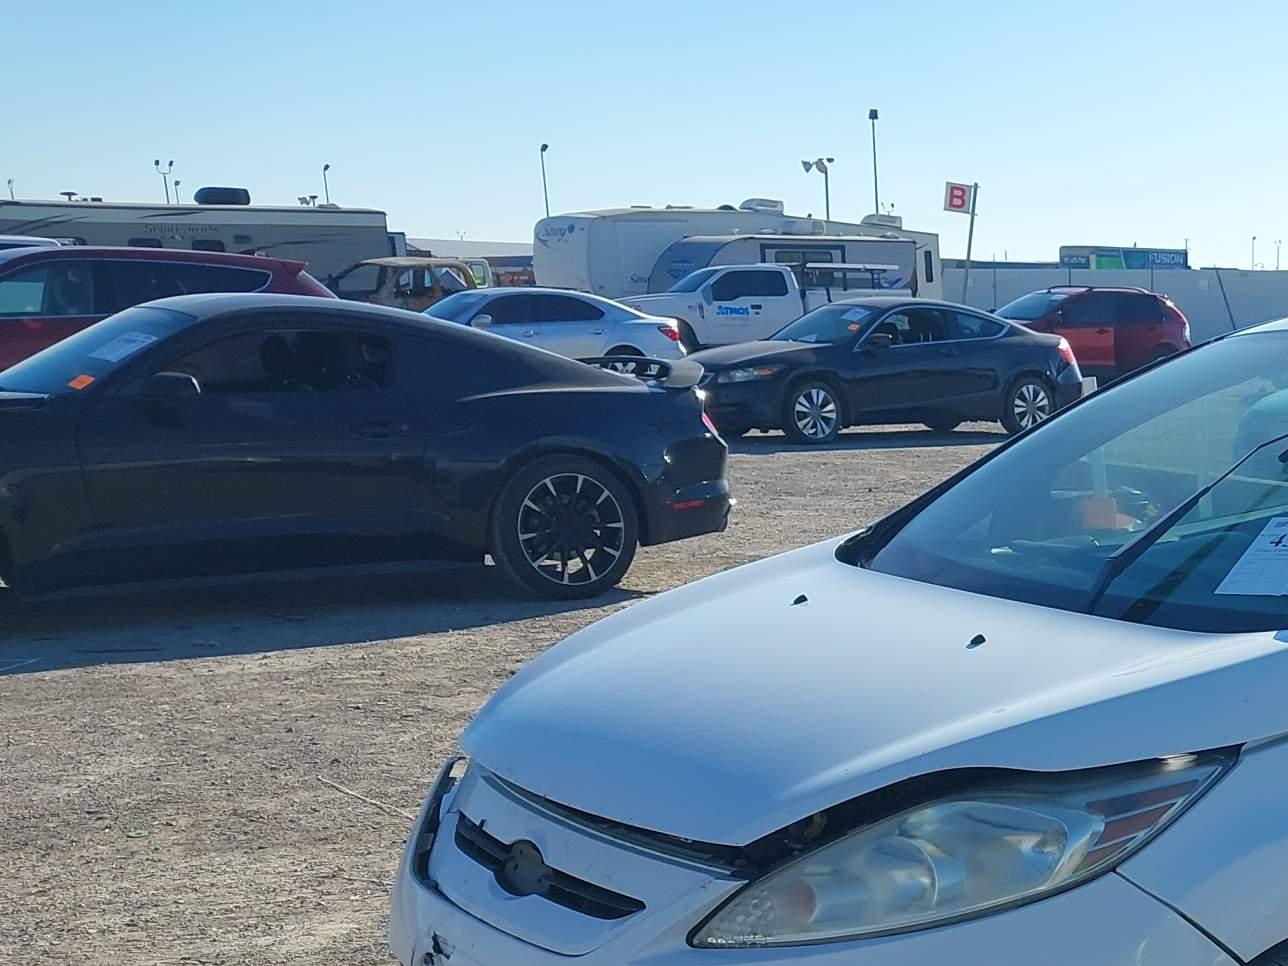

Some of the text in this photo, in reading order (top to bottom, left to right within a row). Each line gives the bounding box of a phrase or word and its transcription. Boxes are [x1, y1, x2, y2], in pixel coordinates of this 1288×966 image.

[948, 186, 967, 209] B
[1149, 252, 1184, 265] FUSION
[716, 305, 750, 316] ATMOS
